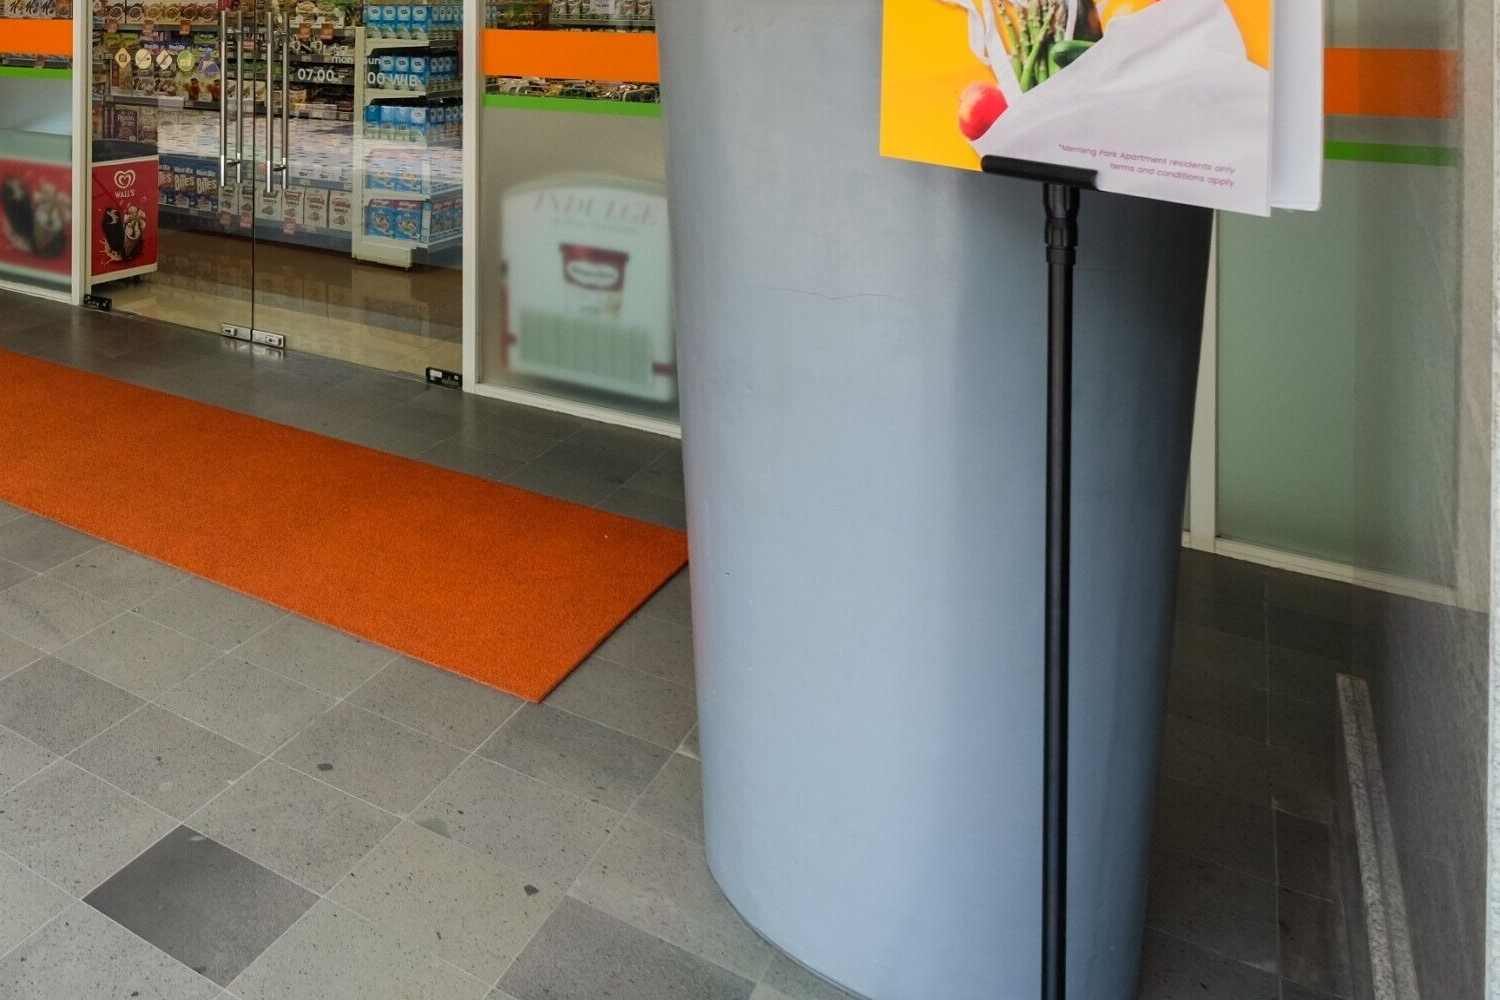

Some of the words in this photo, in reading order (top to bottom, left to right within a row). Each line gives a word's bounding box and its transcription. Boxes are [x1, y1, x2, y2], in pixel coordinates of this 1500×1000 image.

[297, 68, 335, 82] 07.00
[1099, 149, 1118, 158] Park
[1119, 152, 1168, 166] Apartment
[1169, 158, 1212, 171] residents
[1215, 164, 1236, 175] only
[1109, 162, 1135, 174] terms
[1137, 165, 1156, 175] and
[1156, 168, 1206, 183] conditions
[1207, 175, 1236, 188] apply
[114, 190, 136, 199] WALL'S
